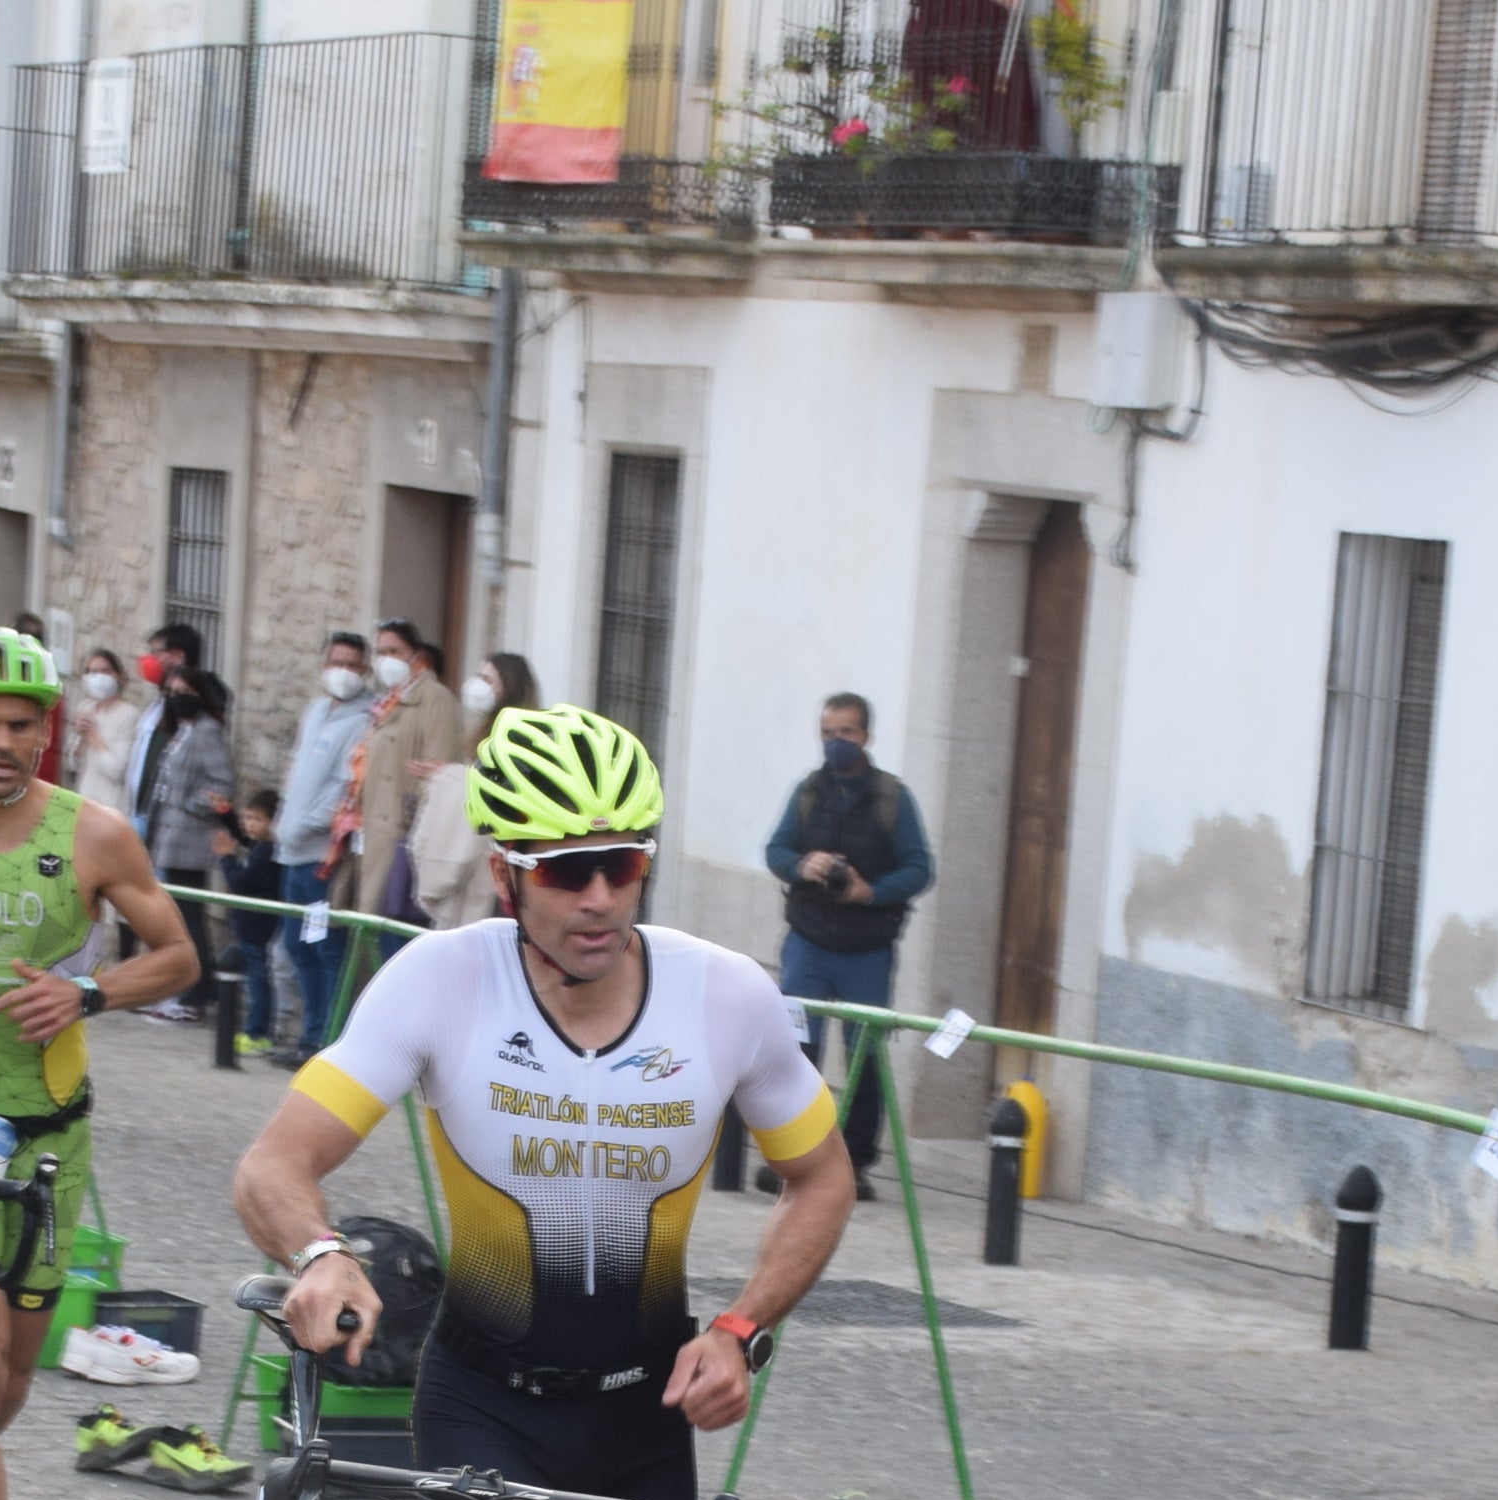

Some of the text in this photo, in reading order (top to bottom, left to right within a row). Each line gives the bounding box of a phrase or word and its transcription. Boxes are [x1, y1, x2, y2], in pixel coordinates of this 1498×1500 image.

[489, 1080, 696, 1129] TRIATLÓN PACENSE
[512, 1134, 672, 1183] MONTERO
